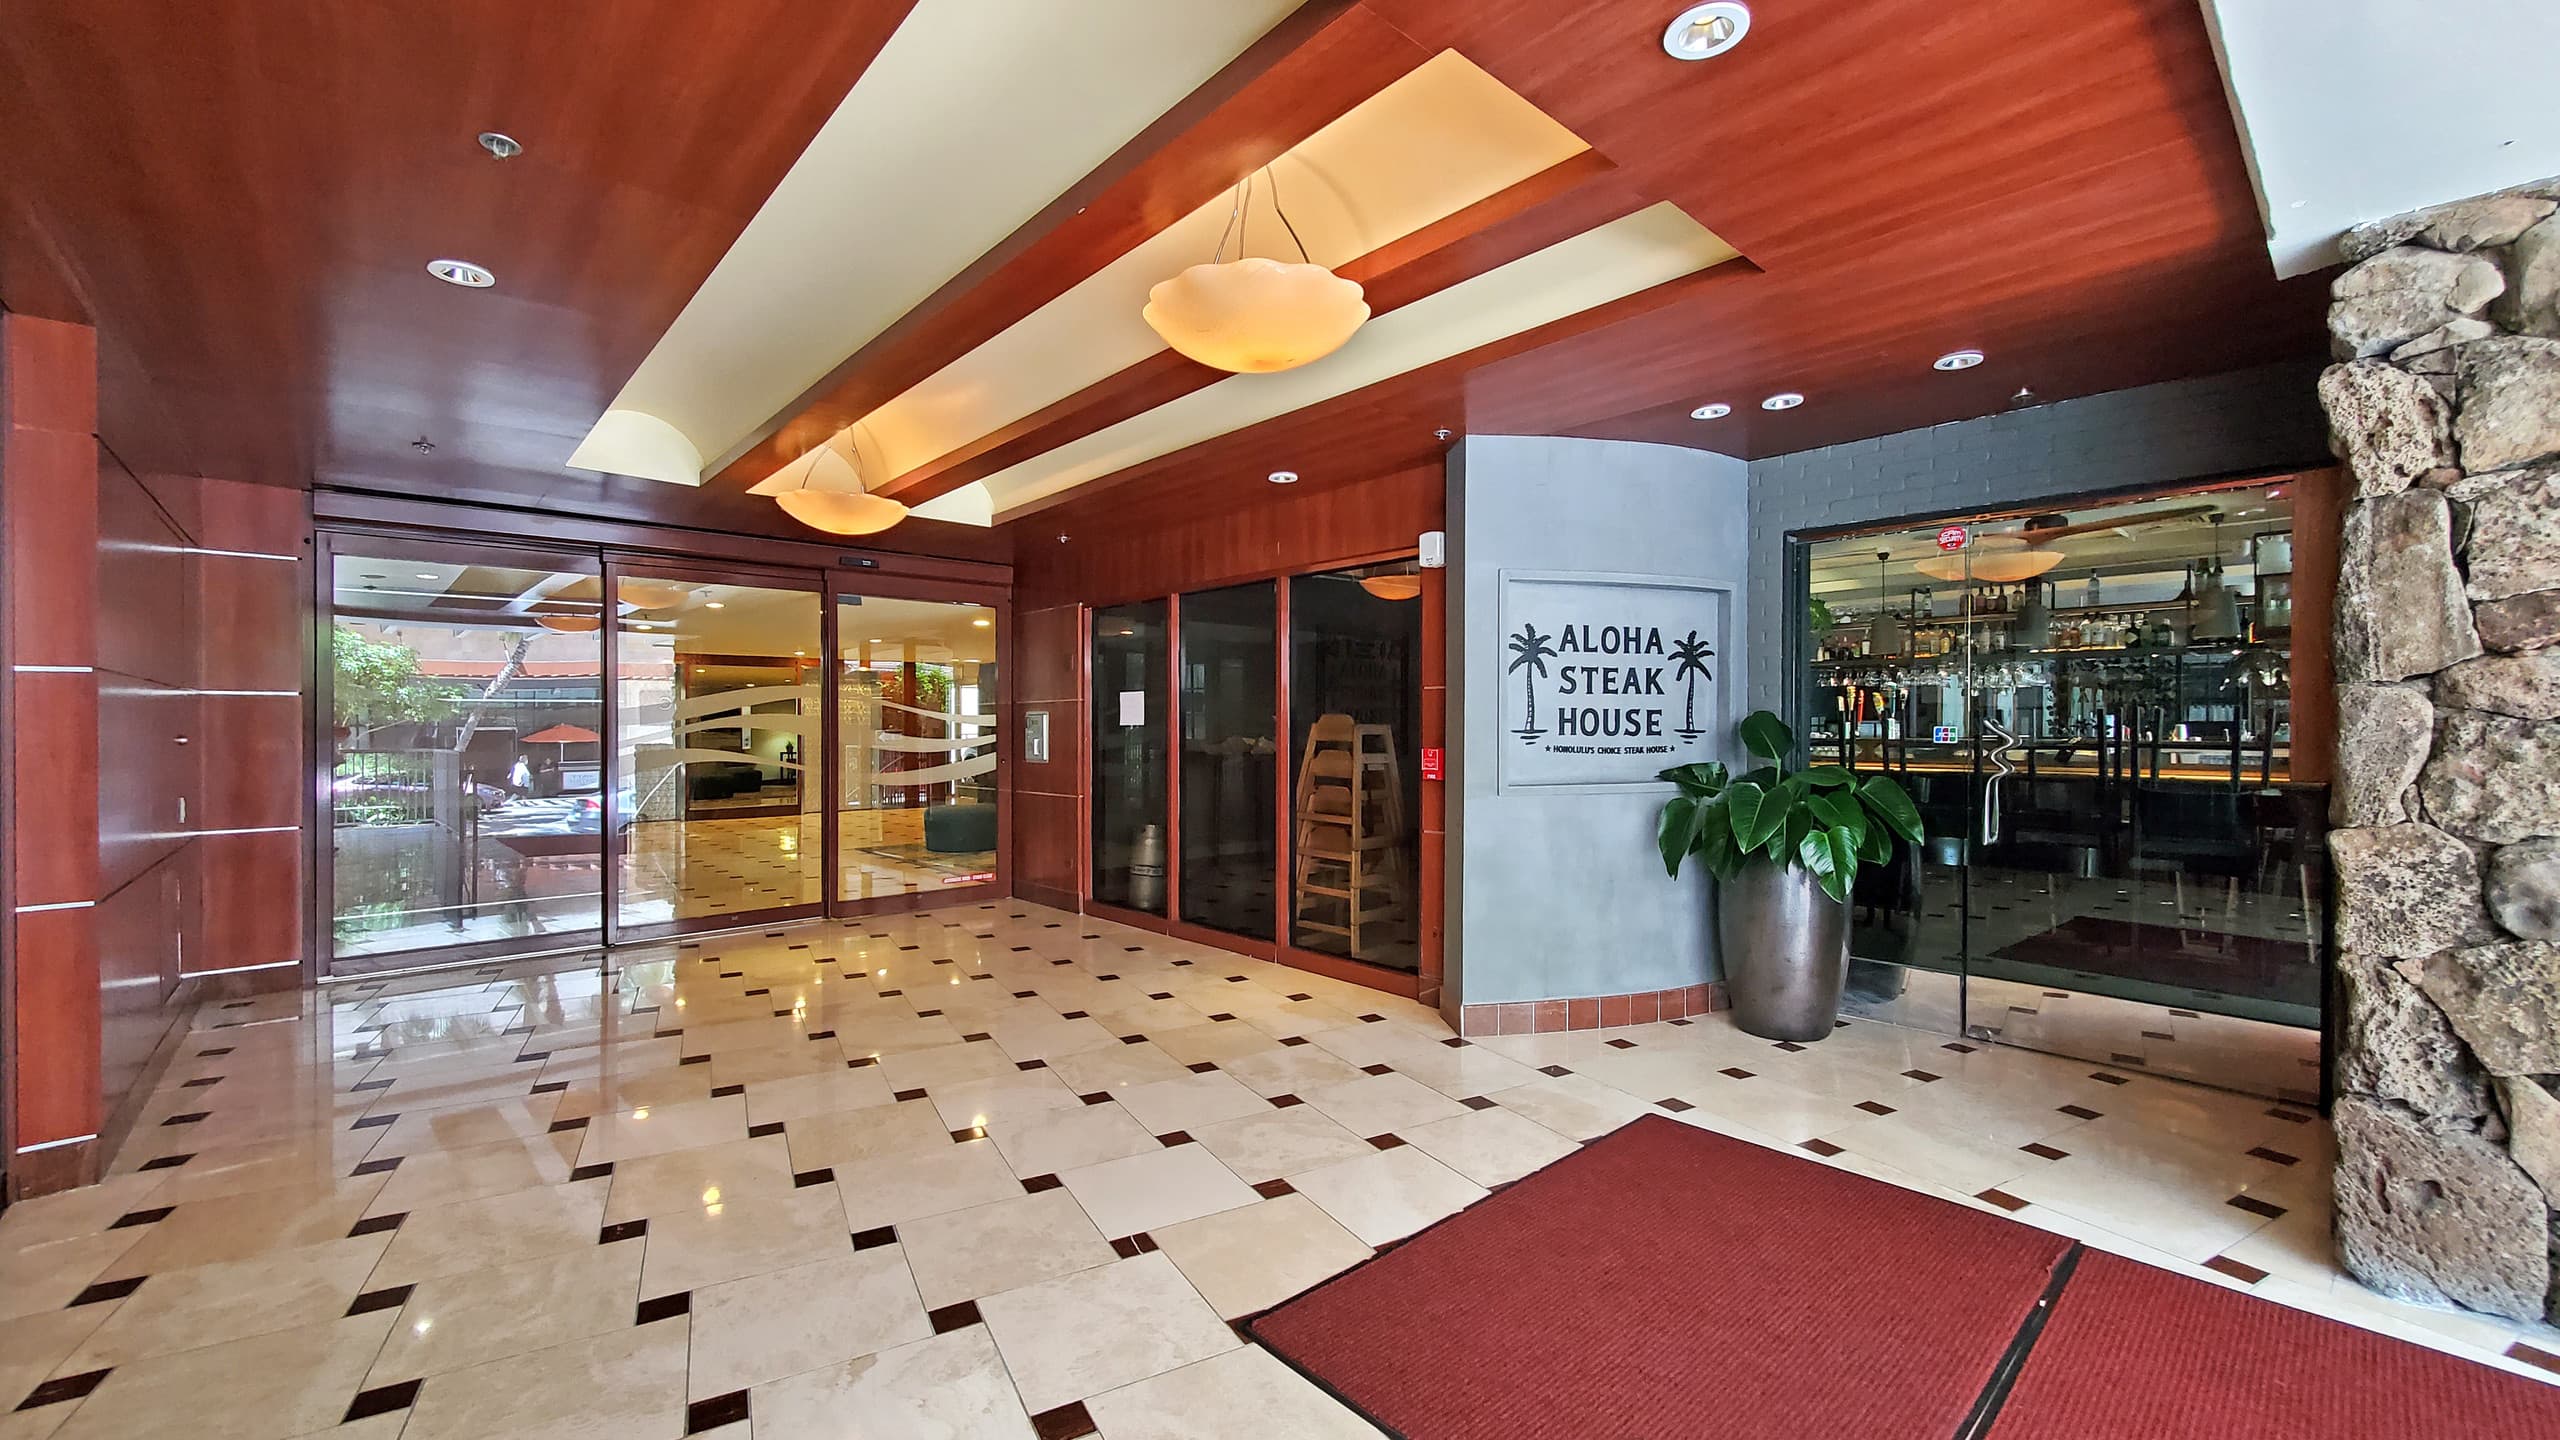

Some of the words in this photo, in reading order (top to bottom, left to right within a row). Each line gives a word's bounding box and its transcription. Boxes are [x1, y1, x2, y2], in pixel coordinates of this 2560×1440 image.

[1558, 624, 1664, 655] ALOHA
[1558, 666, 1665, 695] STEAK
[1558, 708, 1662, 736] HOUSE
[1553, 745, 1595, 754] HONOLULU'S
[1597, 746, 1621, 754] CHOICE
[1624, 746, 1645, 754] STEAK
[1646, 745, 1668, 754] HOUSE
